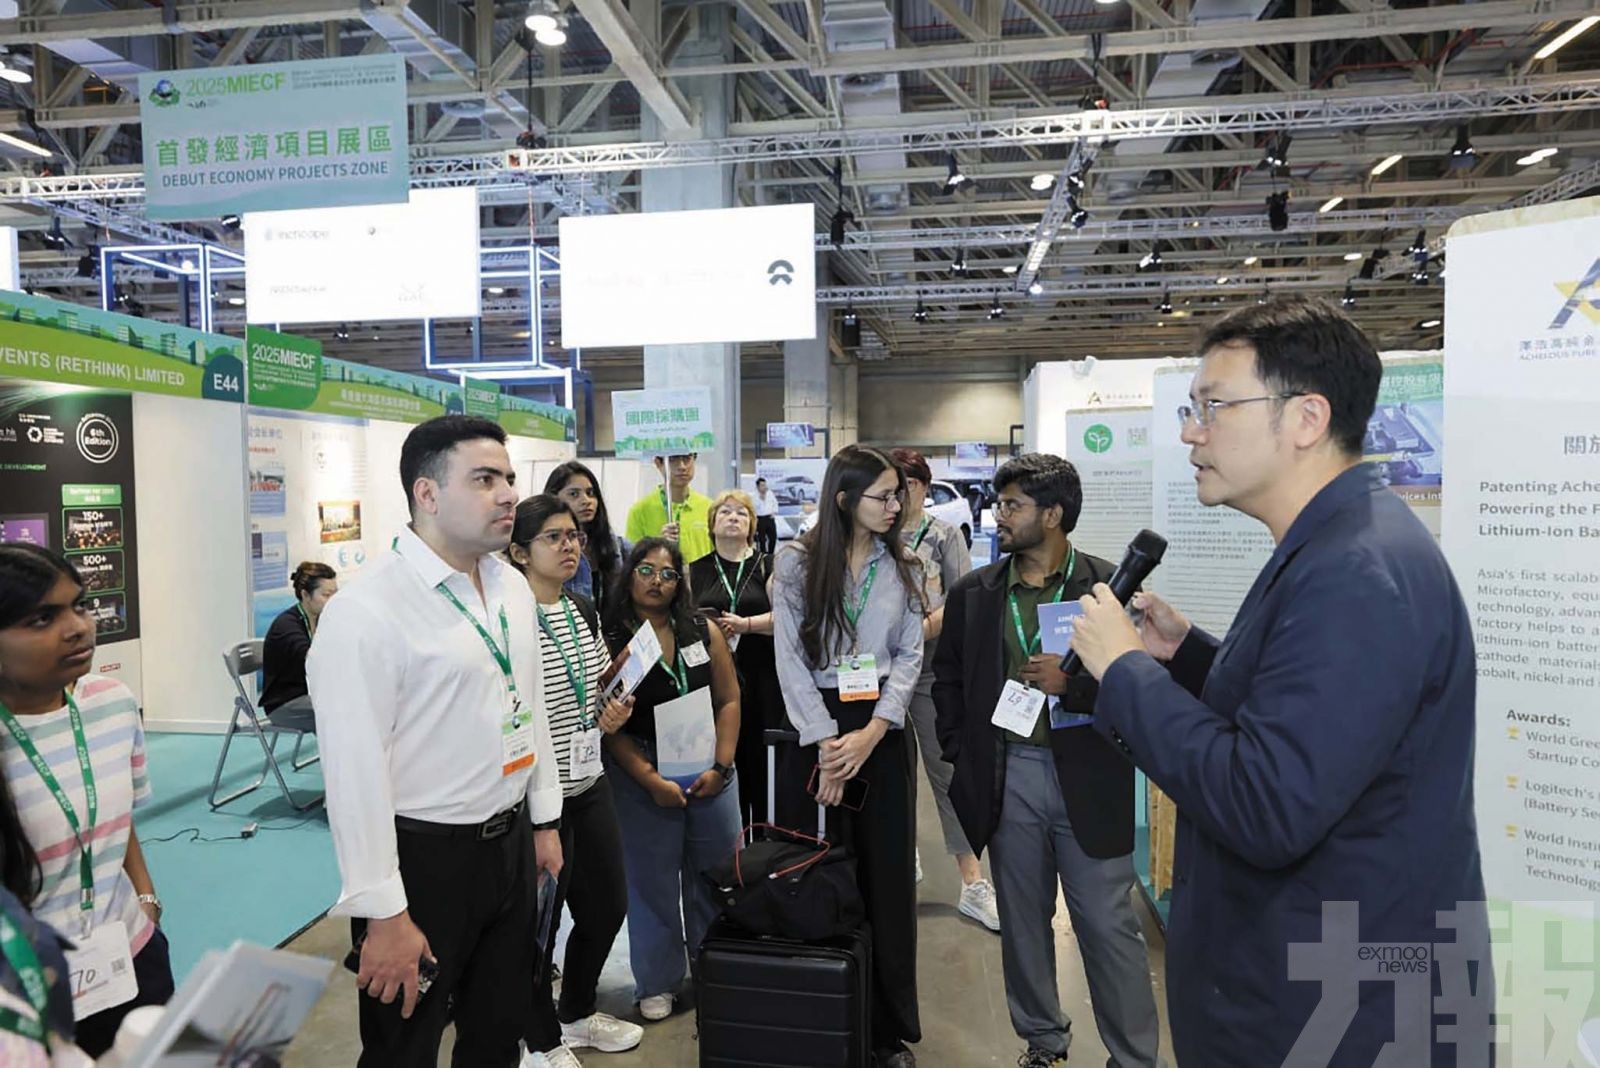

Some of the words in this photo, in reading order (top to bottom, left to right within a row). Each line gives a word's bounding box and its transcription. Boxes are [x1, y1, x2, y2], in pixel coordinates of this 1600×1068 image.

[186, 72, 287, 97] 2025MIECF
[156, 125, 392, 167] 首發經濟項目展區
[162, 172, 205, 188] DEBUT
[209, 167, 274, 185] ECONOMY
[278, 163, 348, 180] PROJECTS
[351, 161, 389, 176] ZONE
[252, 343, 317, 370] 2025MIECF
[55, 357, 131, 382] (RETHINK)
[134, 365, 185, 386] LIMITED
[213, 373, 239, 392] E44
[84, 437, 111, 446] Edition
[1479, 480, 1557, 497] Patenting
[82, 511, 104, 521] 150+
[1479, 503, 1555, 519] Powering
[1560, 503, 1587, 515] the
[1478, 523, 1574, 538] Lithium-Ion
[82, 555, 107, 566] 500+
[1477, 568, 1515, 581] Asia's
[1520, 569, 1547, 582] first
[1477, 584, 1565, 601] Microfactory,
[93, 598, 101, 608] 9
[1476, 601, 1555, 618] technology,
[1476, 616, 1522, 632] factory
[1527, 621, 1565, 634] helps
[1571, 624, 1585, 635] to
[1476, 632, 1549, 649] lithium-ion
[1475, 651, 1530, 665] cathode
[1475, 666, 1520, 682] cobalt,
[1523, 670, 1563, 685] nickel
[1567, 677, 1594, 688] and
[1506, 708, 1571, 728] Awards:
[1526, 730, 1566, 746] World
[1527, 748, 1578, 767] Startup
[1525, 780, 1595, 800] Logitech's
[1523, 797, 1578, 817] (Battery
[1524, 828, 1564, 845] World
[1526, 847, 1589, 868] Planners'
